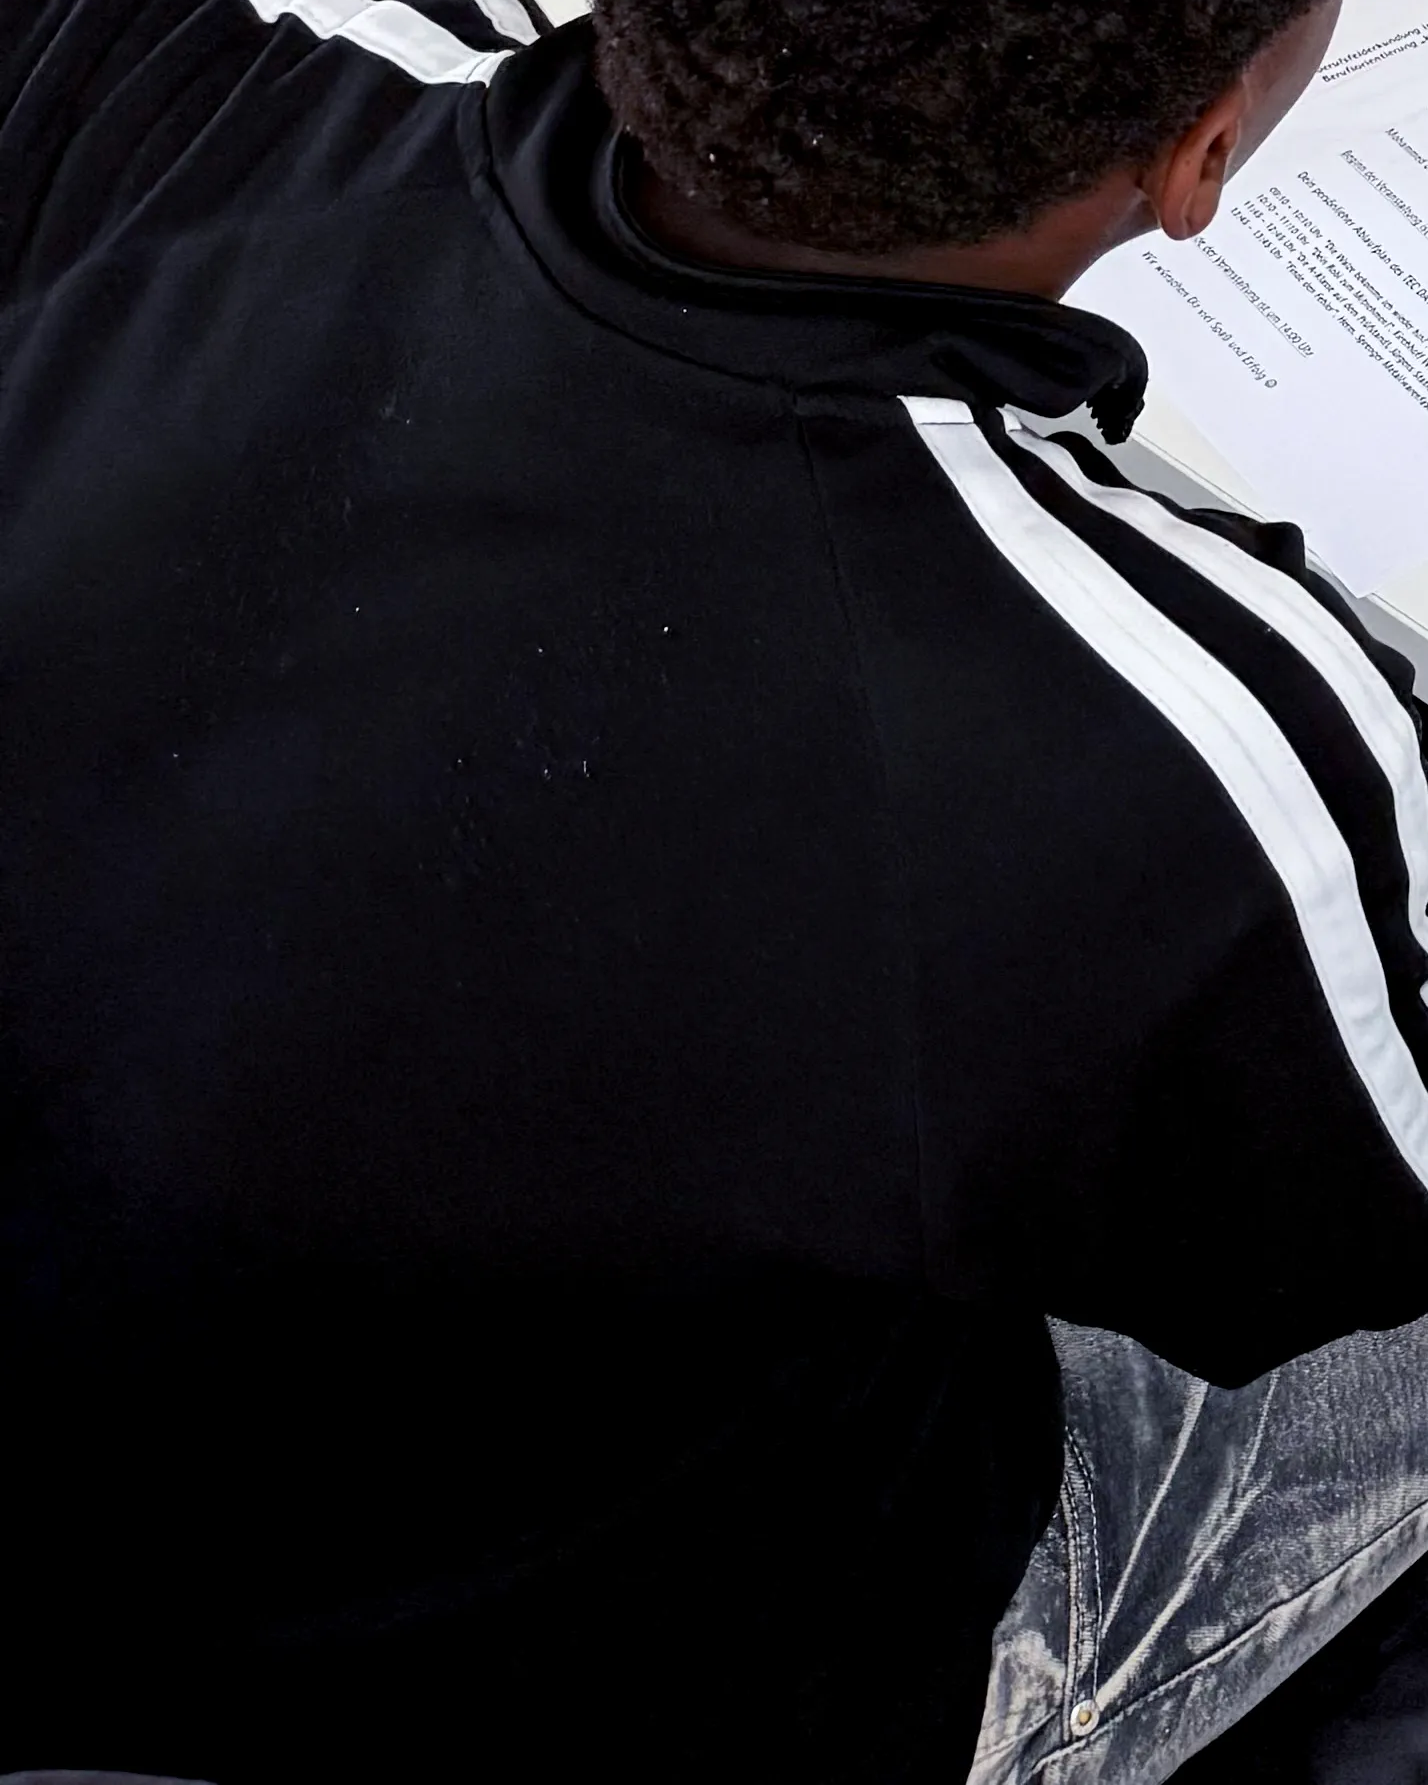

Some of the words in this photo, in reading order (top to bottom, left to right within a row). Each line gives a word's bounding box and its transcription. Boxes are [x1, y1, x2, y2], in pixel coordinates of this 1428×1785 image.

[1340, 149, 1367, 174] Beginn
[1363, 171, 1380, 183] der
[1351, 226, 1392, 265] Ablaufplan
[1402, 274, 1422, 291] TEC
[1241, 355, 1267, 381] Erfolg
